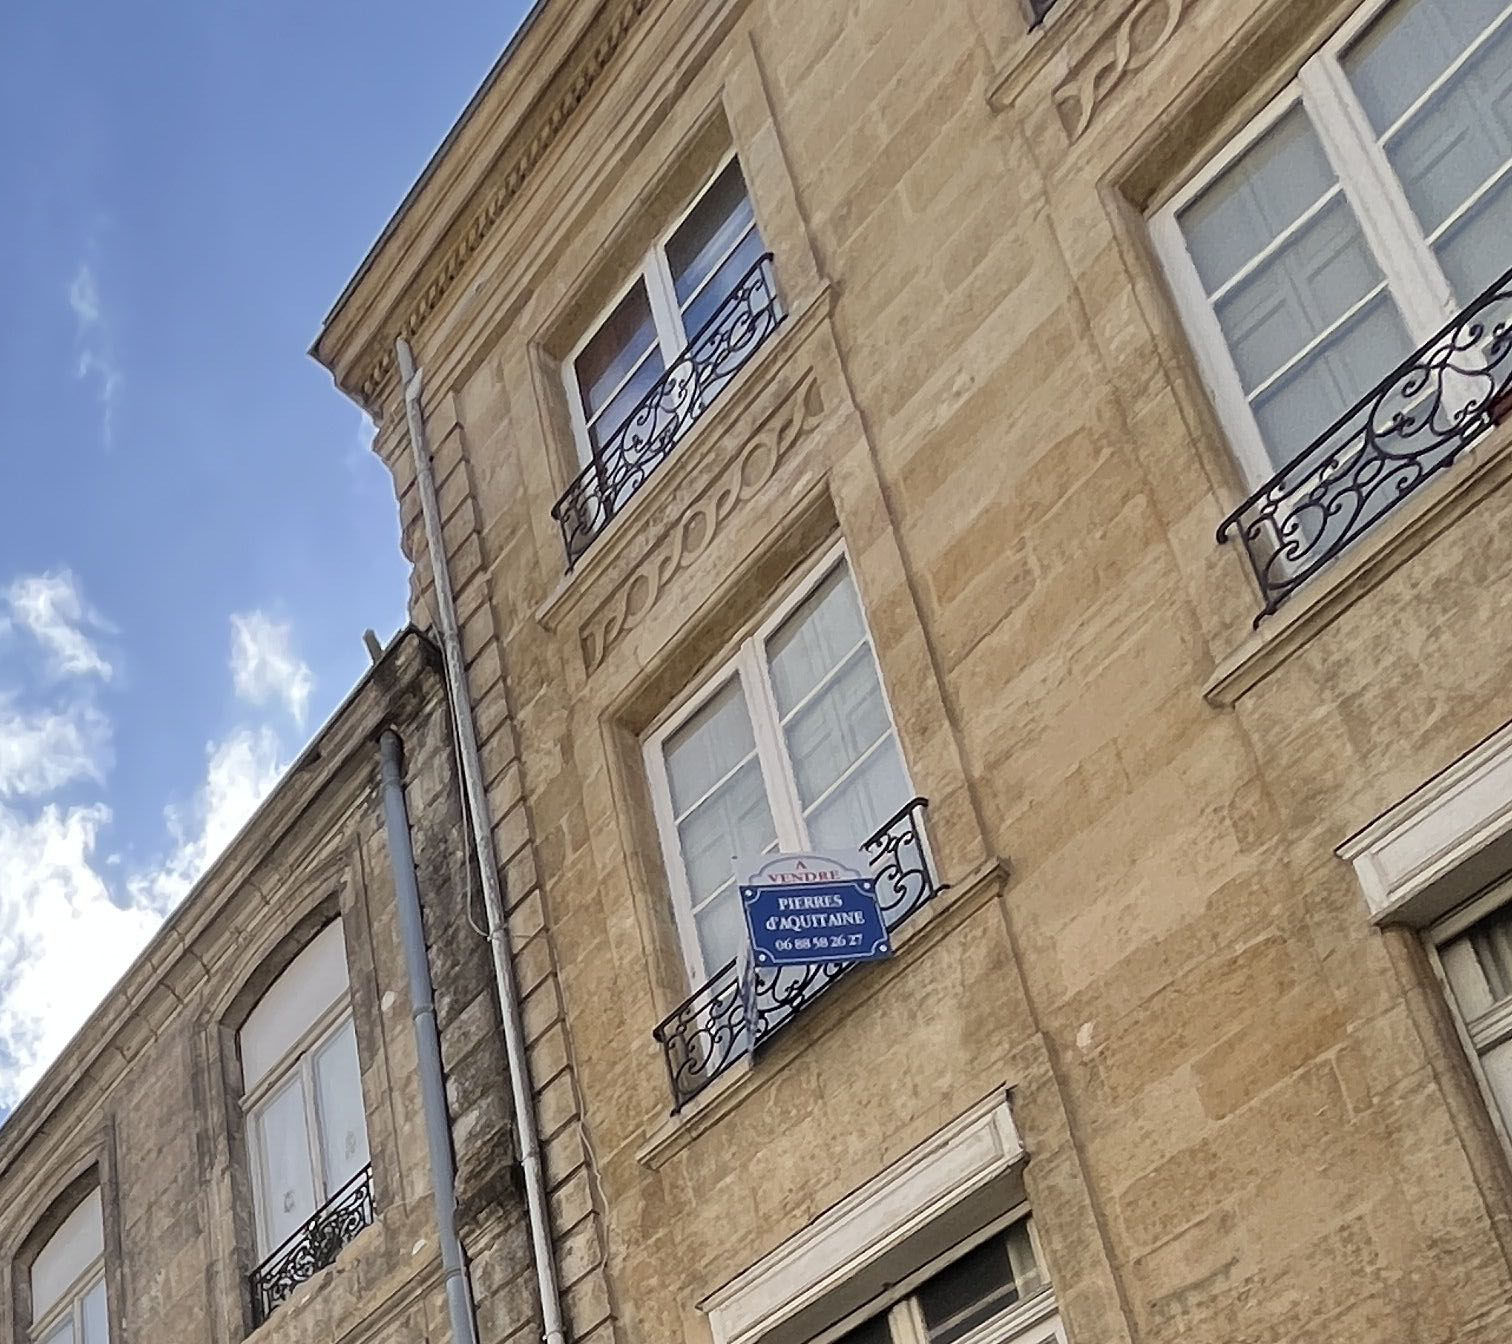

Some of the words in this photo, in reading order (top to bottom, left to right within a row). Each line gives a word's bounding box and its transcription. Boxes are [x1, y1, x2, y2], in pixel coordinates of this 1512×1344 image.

[796, 861, 807, 869] A
[768, 871, 840, 883] VENDRE
[778, 895, 842, 911] PIERRES
[767, 912, 865, 931] d'AQUITAINE
[775, 938, 792, 950] 06
[830, 934, 847, 948] 26
[848, 933, 863, 946] 27
